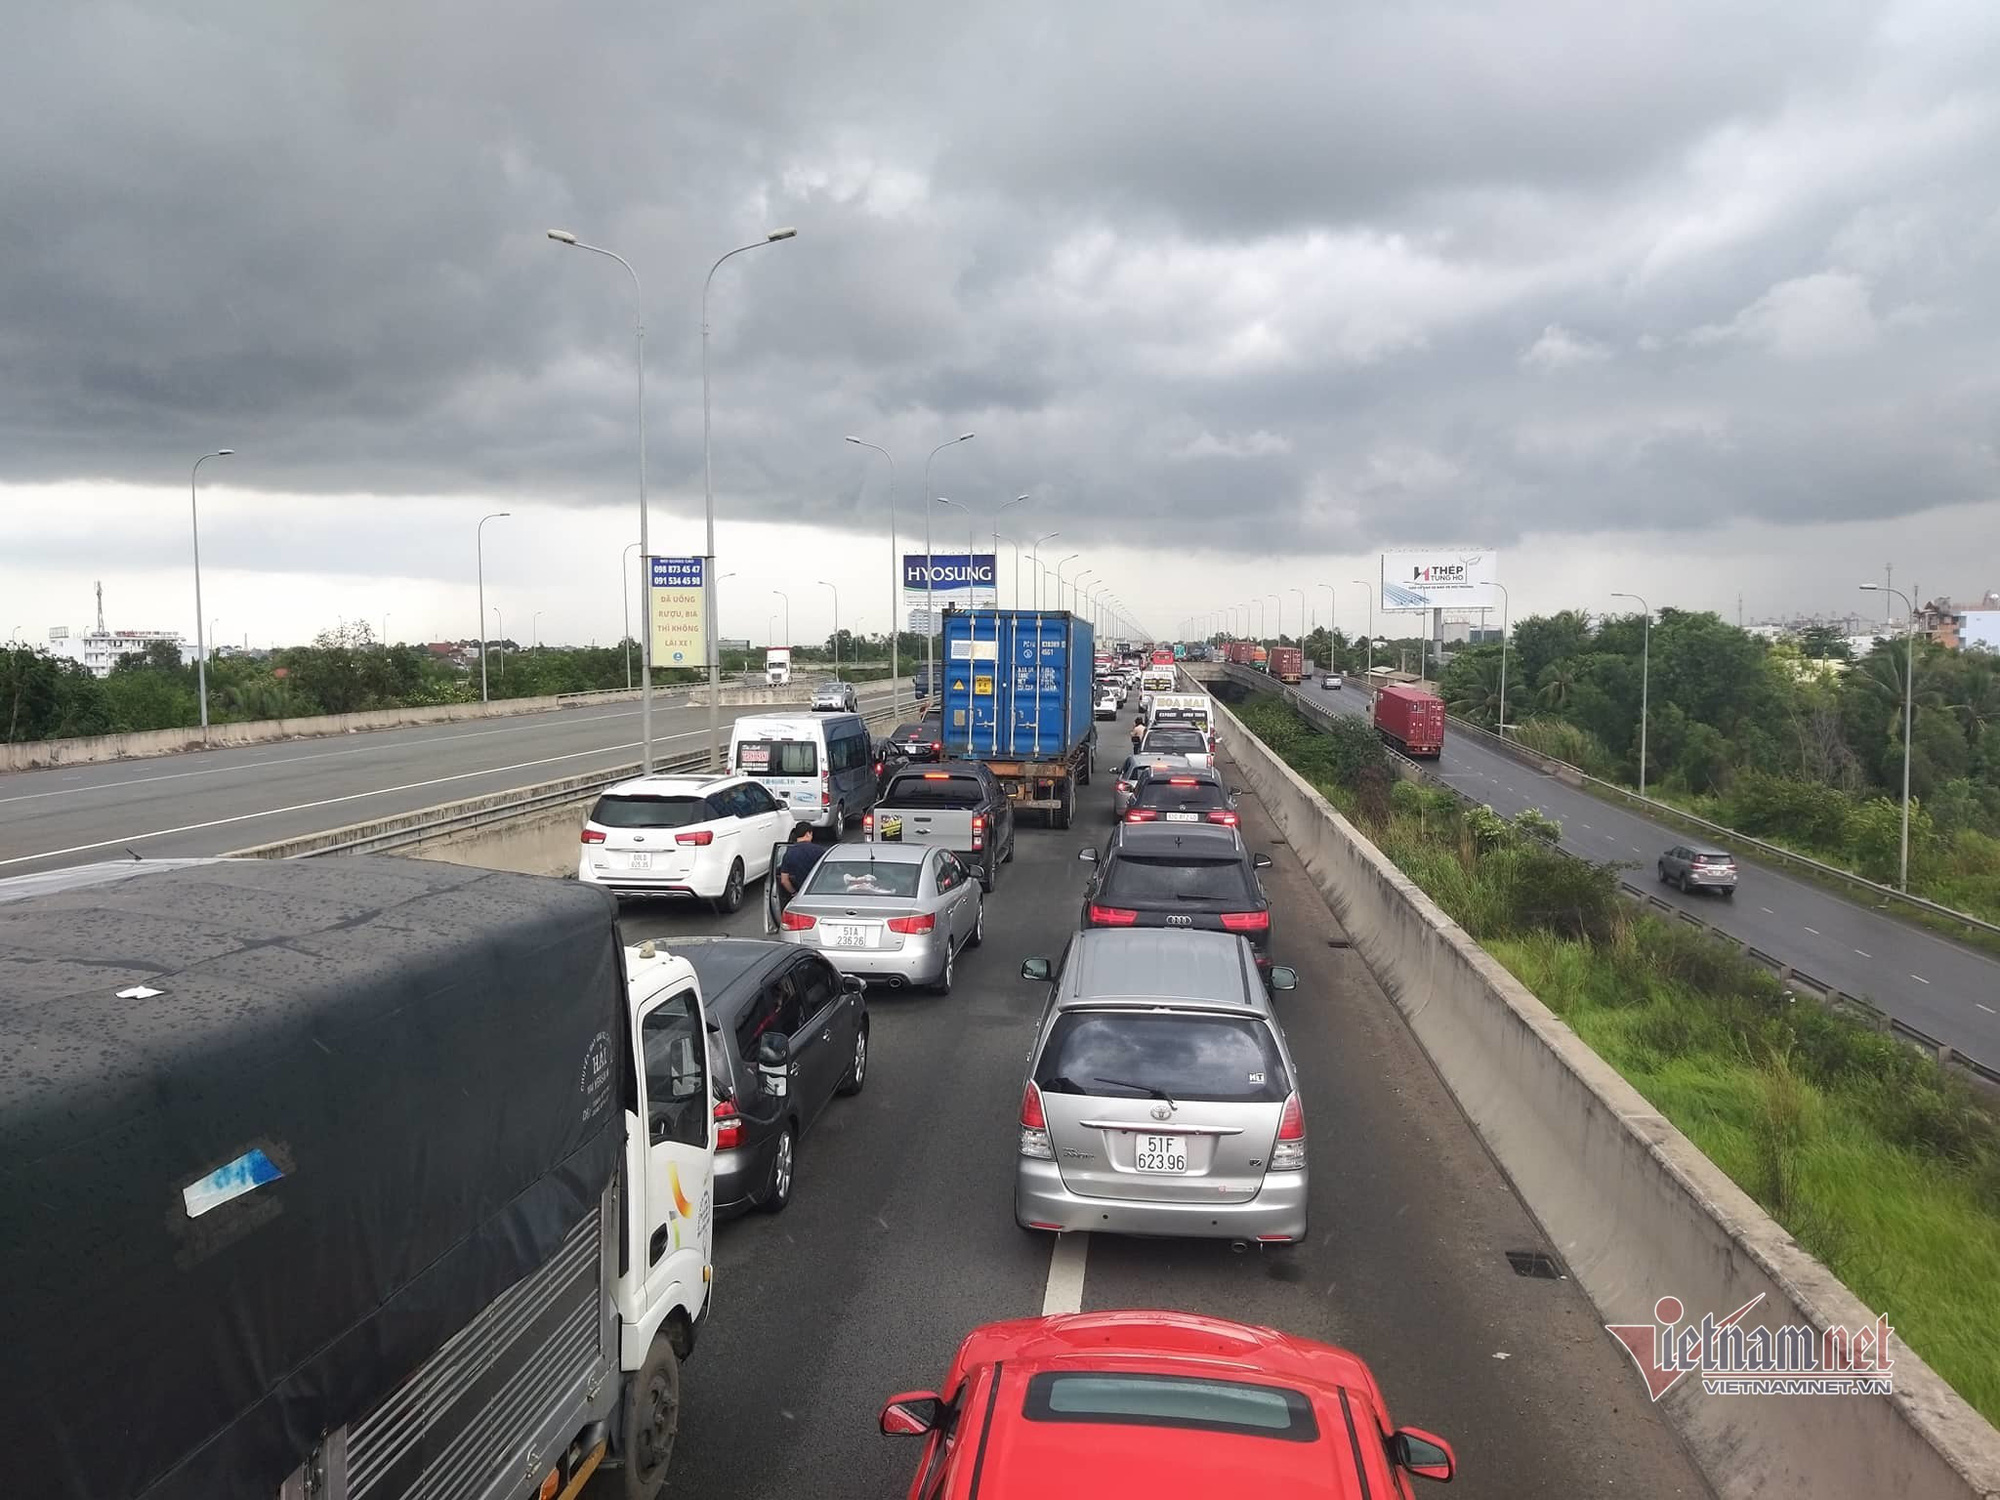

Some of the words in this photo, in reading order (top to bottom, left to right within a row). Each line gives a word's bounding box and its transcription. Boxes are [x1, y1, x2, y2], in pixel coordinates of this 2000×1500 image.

[682, 565, 691, 573] 45
[691, 565, 701, 573] 47
[908, 566, 992, 581] HYOSUNG
[682, 576, 691, 585] 45
[843, 926, 858, 936] 51A
[1148, 1137, 1175, 1153] 51F
[1138, 1152, 1185, 1170] 623.96
